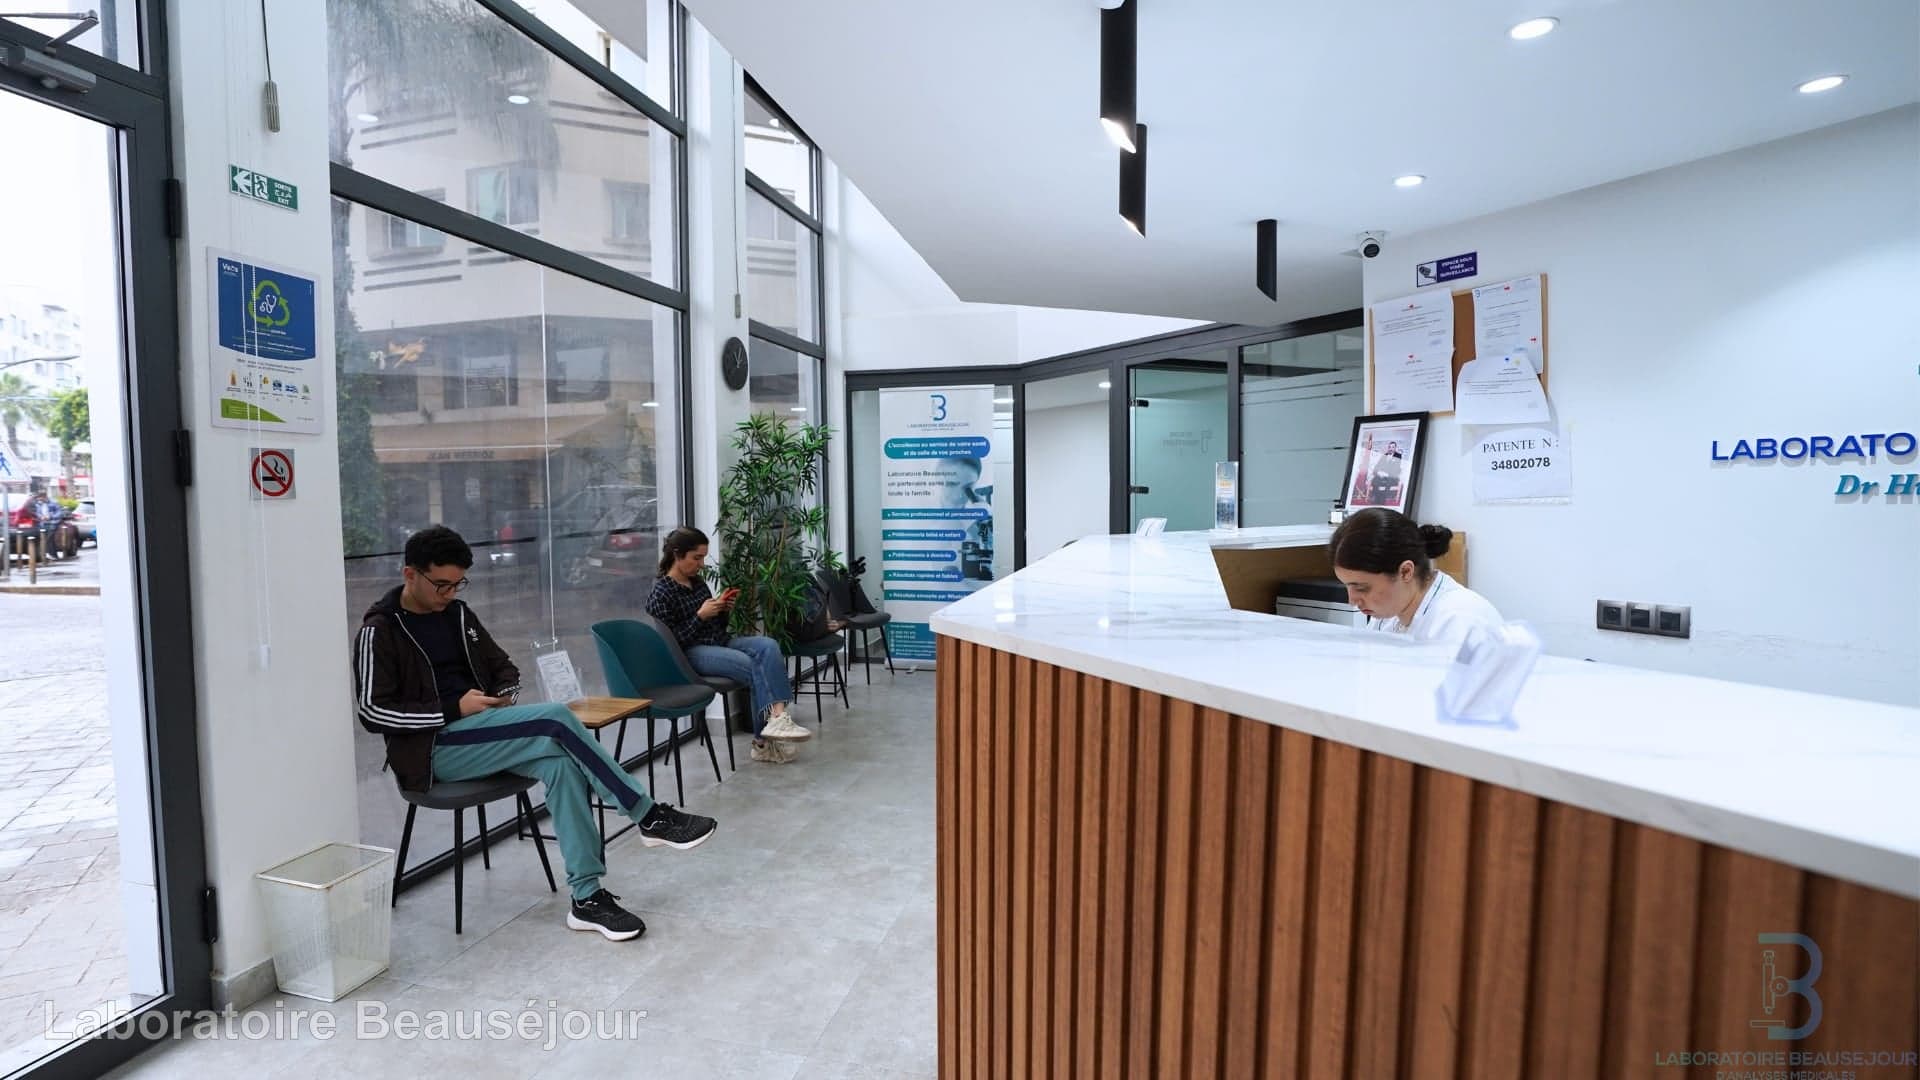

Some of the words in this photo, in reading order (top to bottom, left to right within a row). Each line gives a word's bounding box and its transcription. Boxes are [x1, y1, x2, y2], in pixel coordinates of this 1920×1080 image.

[1483, 439, 1536, 453] PATENTE
[1711, 432, 1917, 461] LABORATO
[1490, 456, 1551, 471] 34802078
[1834, 474, 1878, 496] Dr
